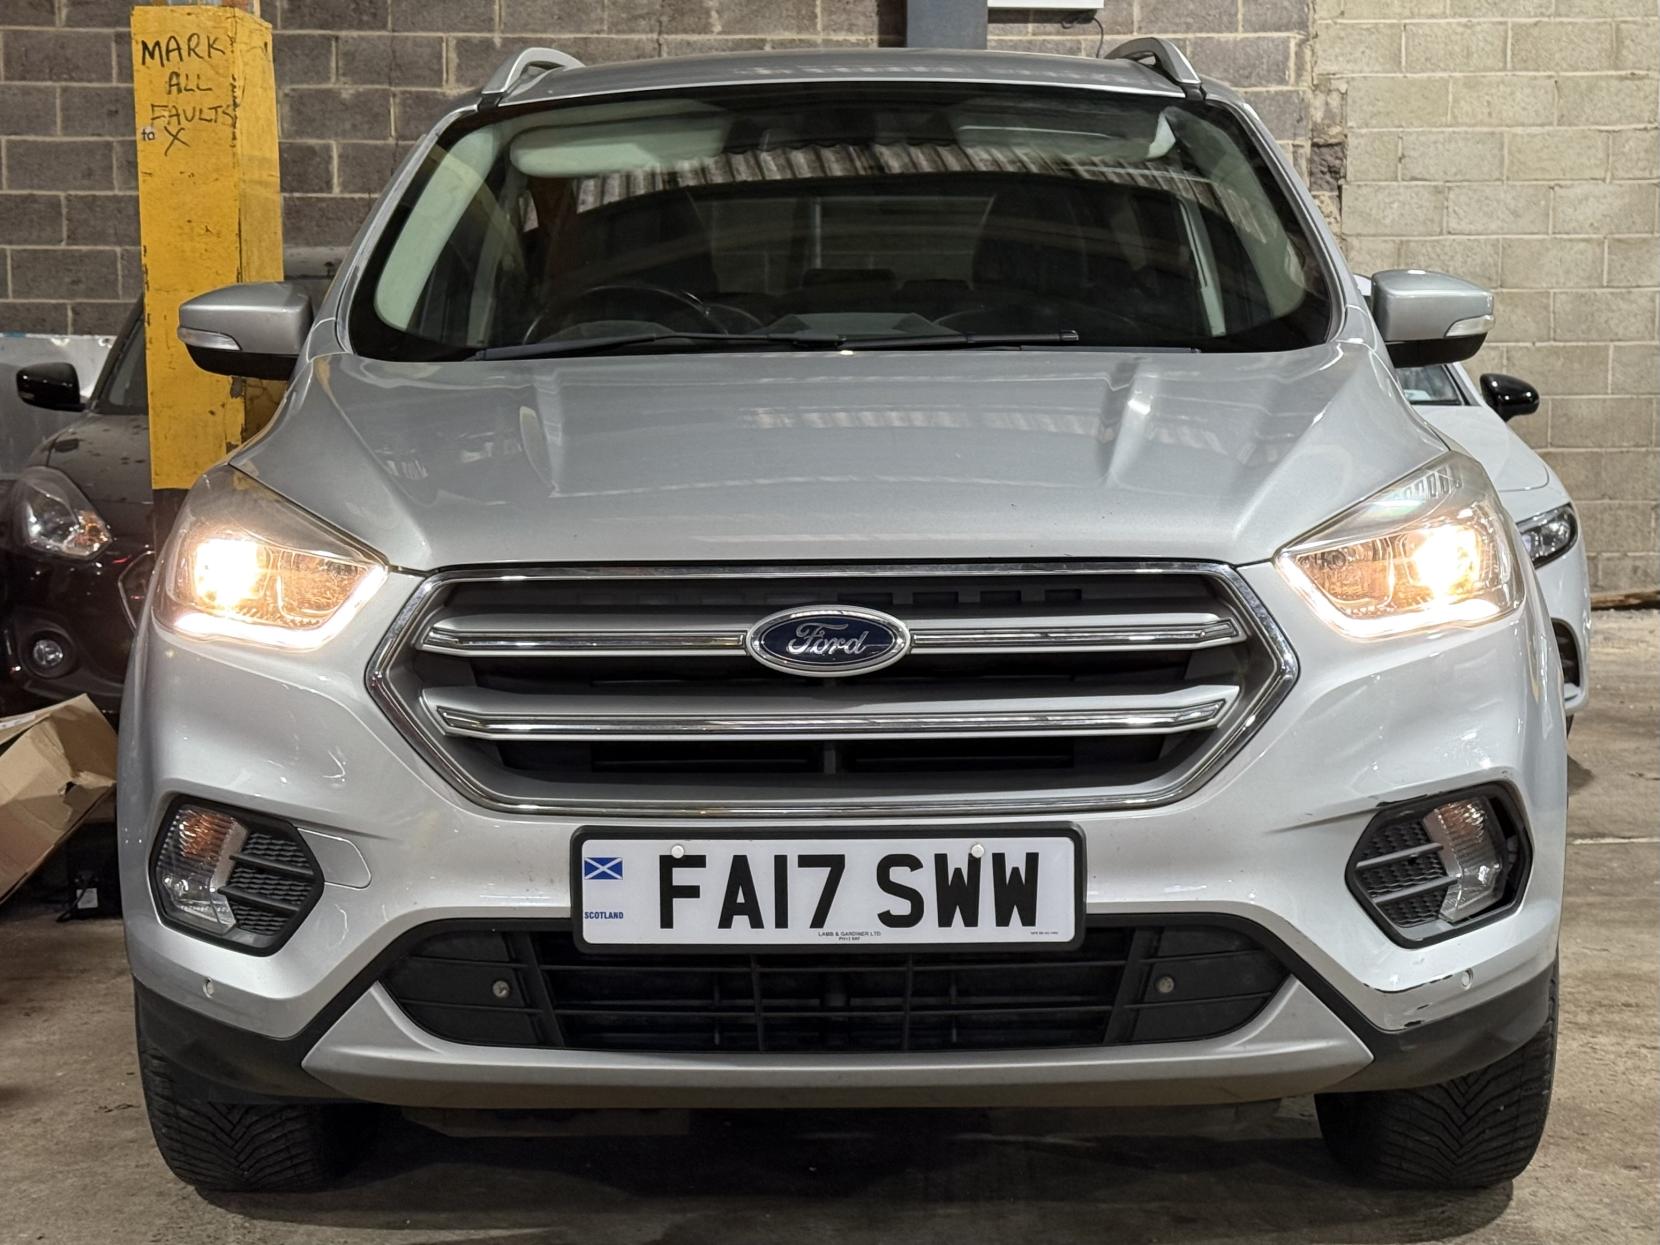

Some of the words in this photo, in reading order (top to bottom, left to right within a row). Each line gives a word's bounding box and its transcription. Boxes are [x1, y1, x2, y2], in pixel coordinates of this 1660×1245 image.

[141, 33, 226, 67] MARK
[167, 71, 212, 95] ALL
[151, 103, 236, 125] FAULTS
[787, 622, 886, 655] Ford
[659, 854, 845, 929] FA17
[876, 852, 1039, 928] SWW
[584, 911, 624, 920] SCOTLAND
